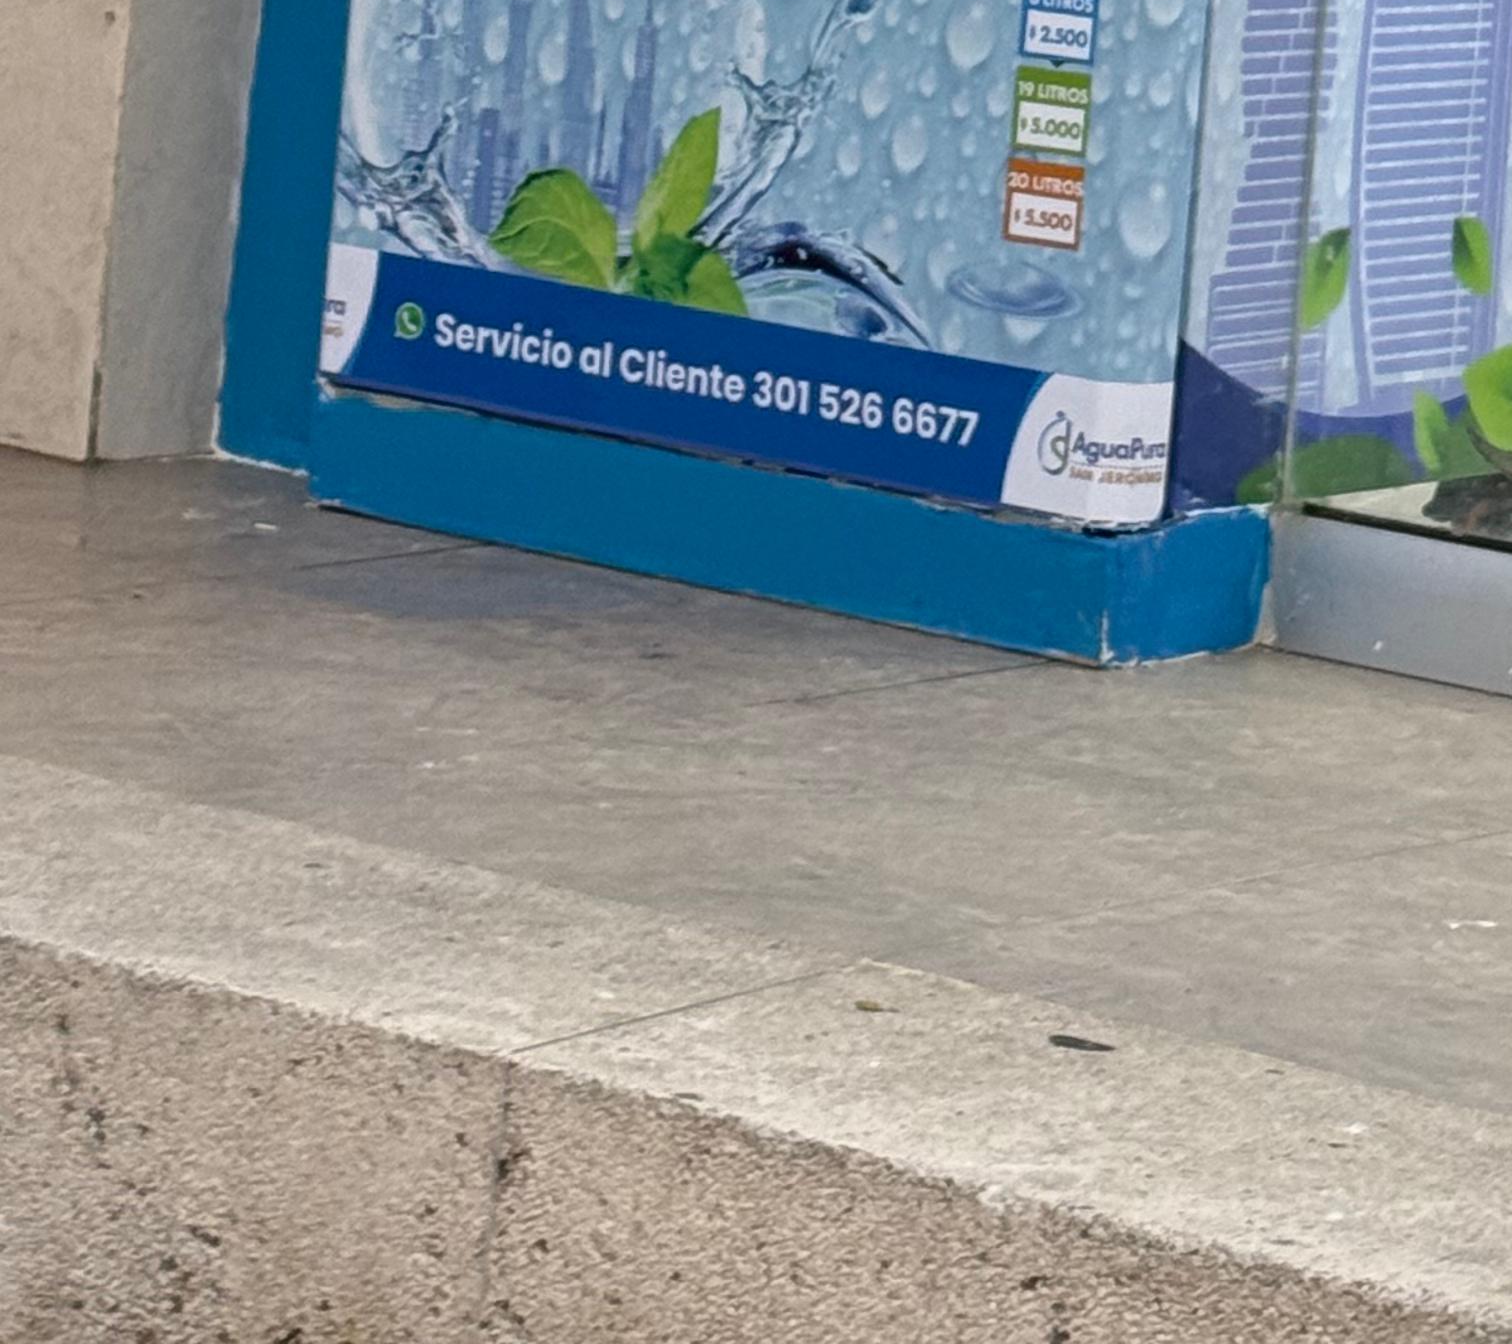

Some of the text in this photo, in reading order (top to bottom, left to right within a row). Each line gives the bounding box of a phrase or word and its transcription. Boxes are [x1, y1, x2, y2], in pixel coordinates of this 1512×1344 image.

[1018, 80, 1089, 105] 19 LITROS
[1008, 172, 1084, 197] 20 LITROS
[433, 312, 980, 449] Servicio al Cliente 301 526 6677
